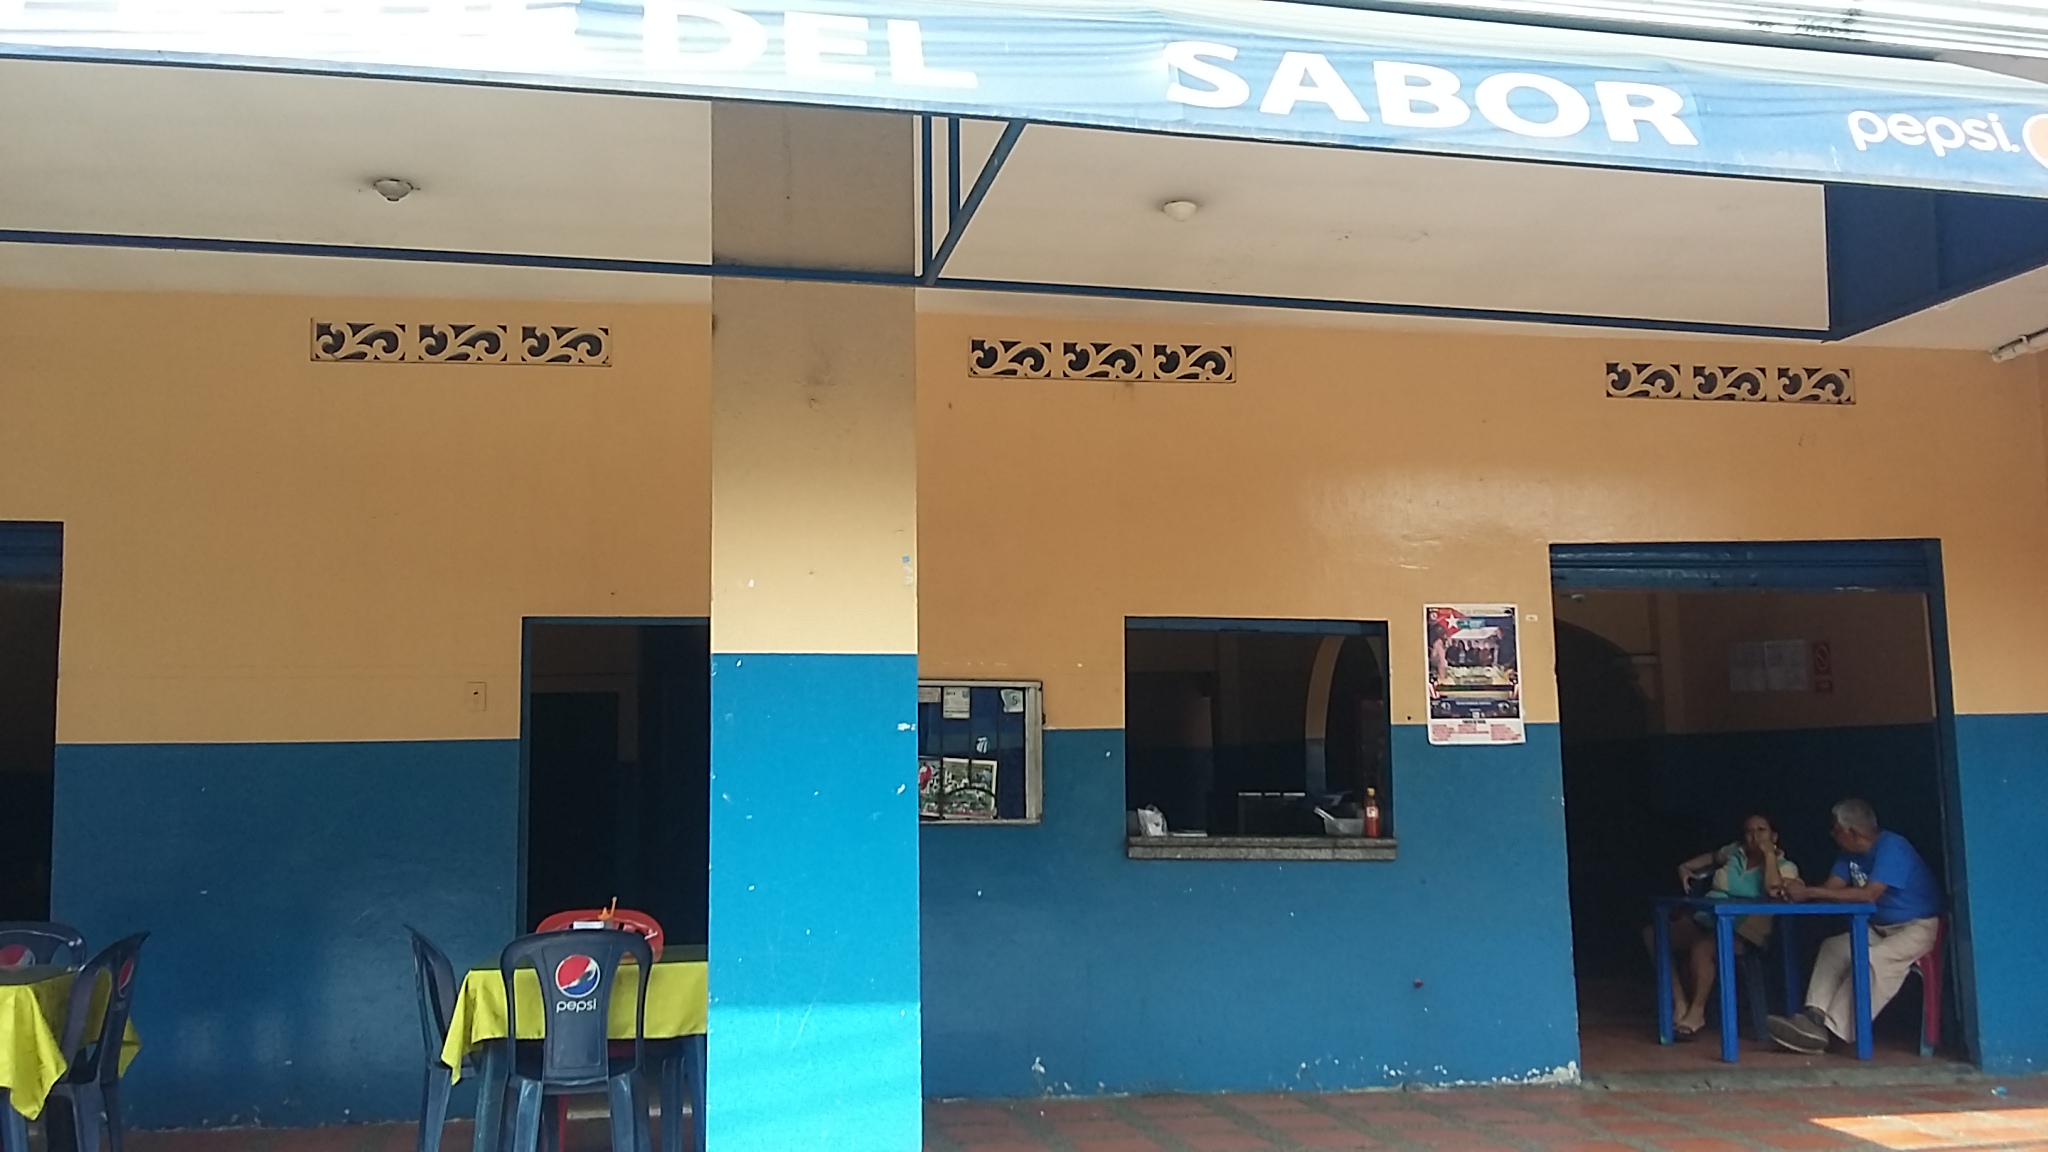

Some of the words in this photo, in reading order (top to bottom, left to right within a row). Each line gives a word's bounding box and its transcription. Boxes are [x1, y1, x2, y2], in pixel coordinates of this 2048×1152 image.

[642, 0, 978, 88] DEL
[1164, 40, 1699, 146] SABOR
[556, 998, 597, 1014] pepsi
